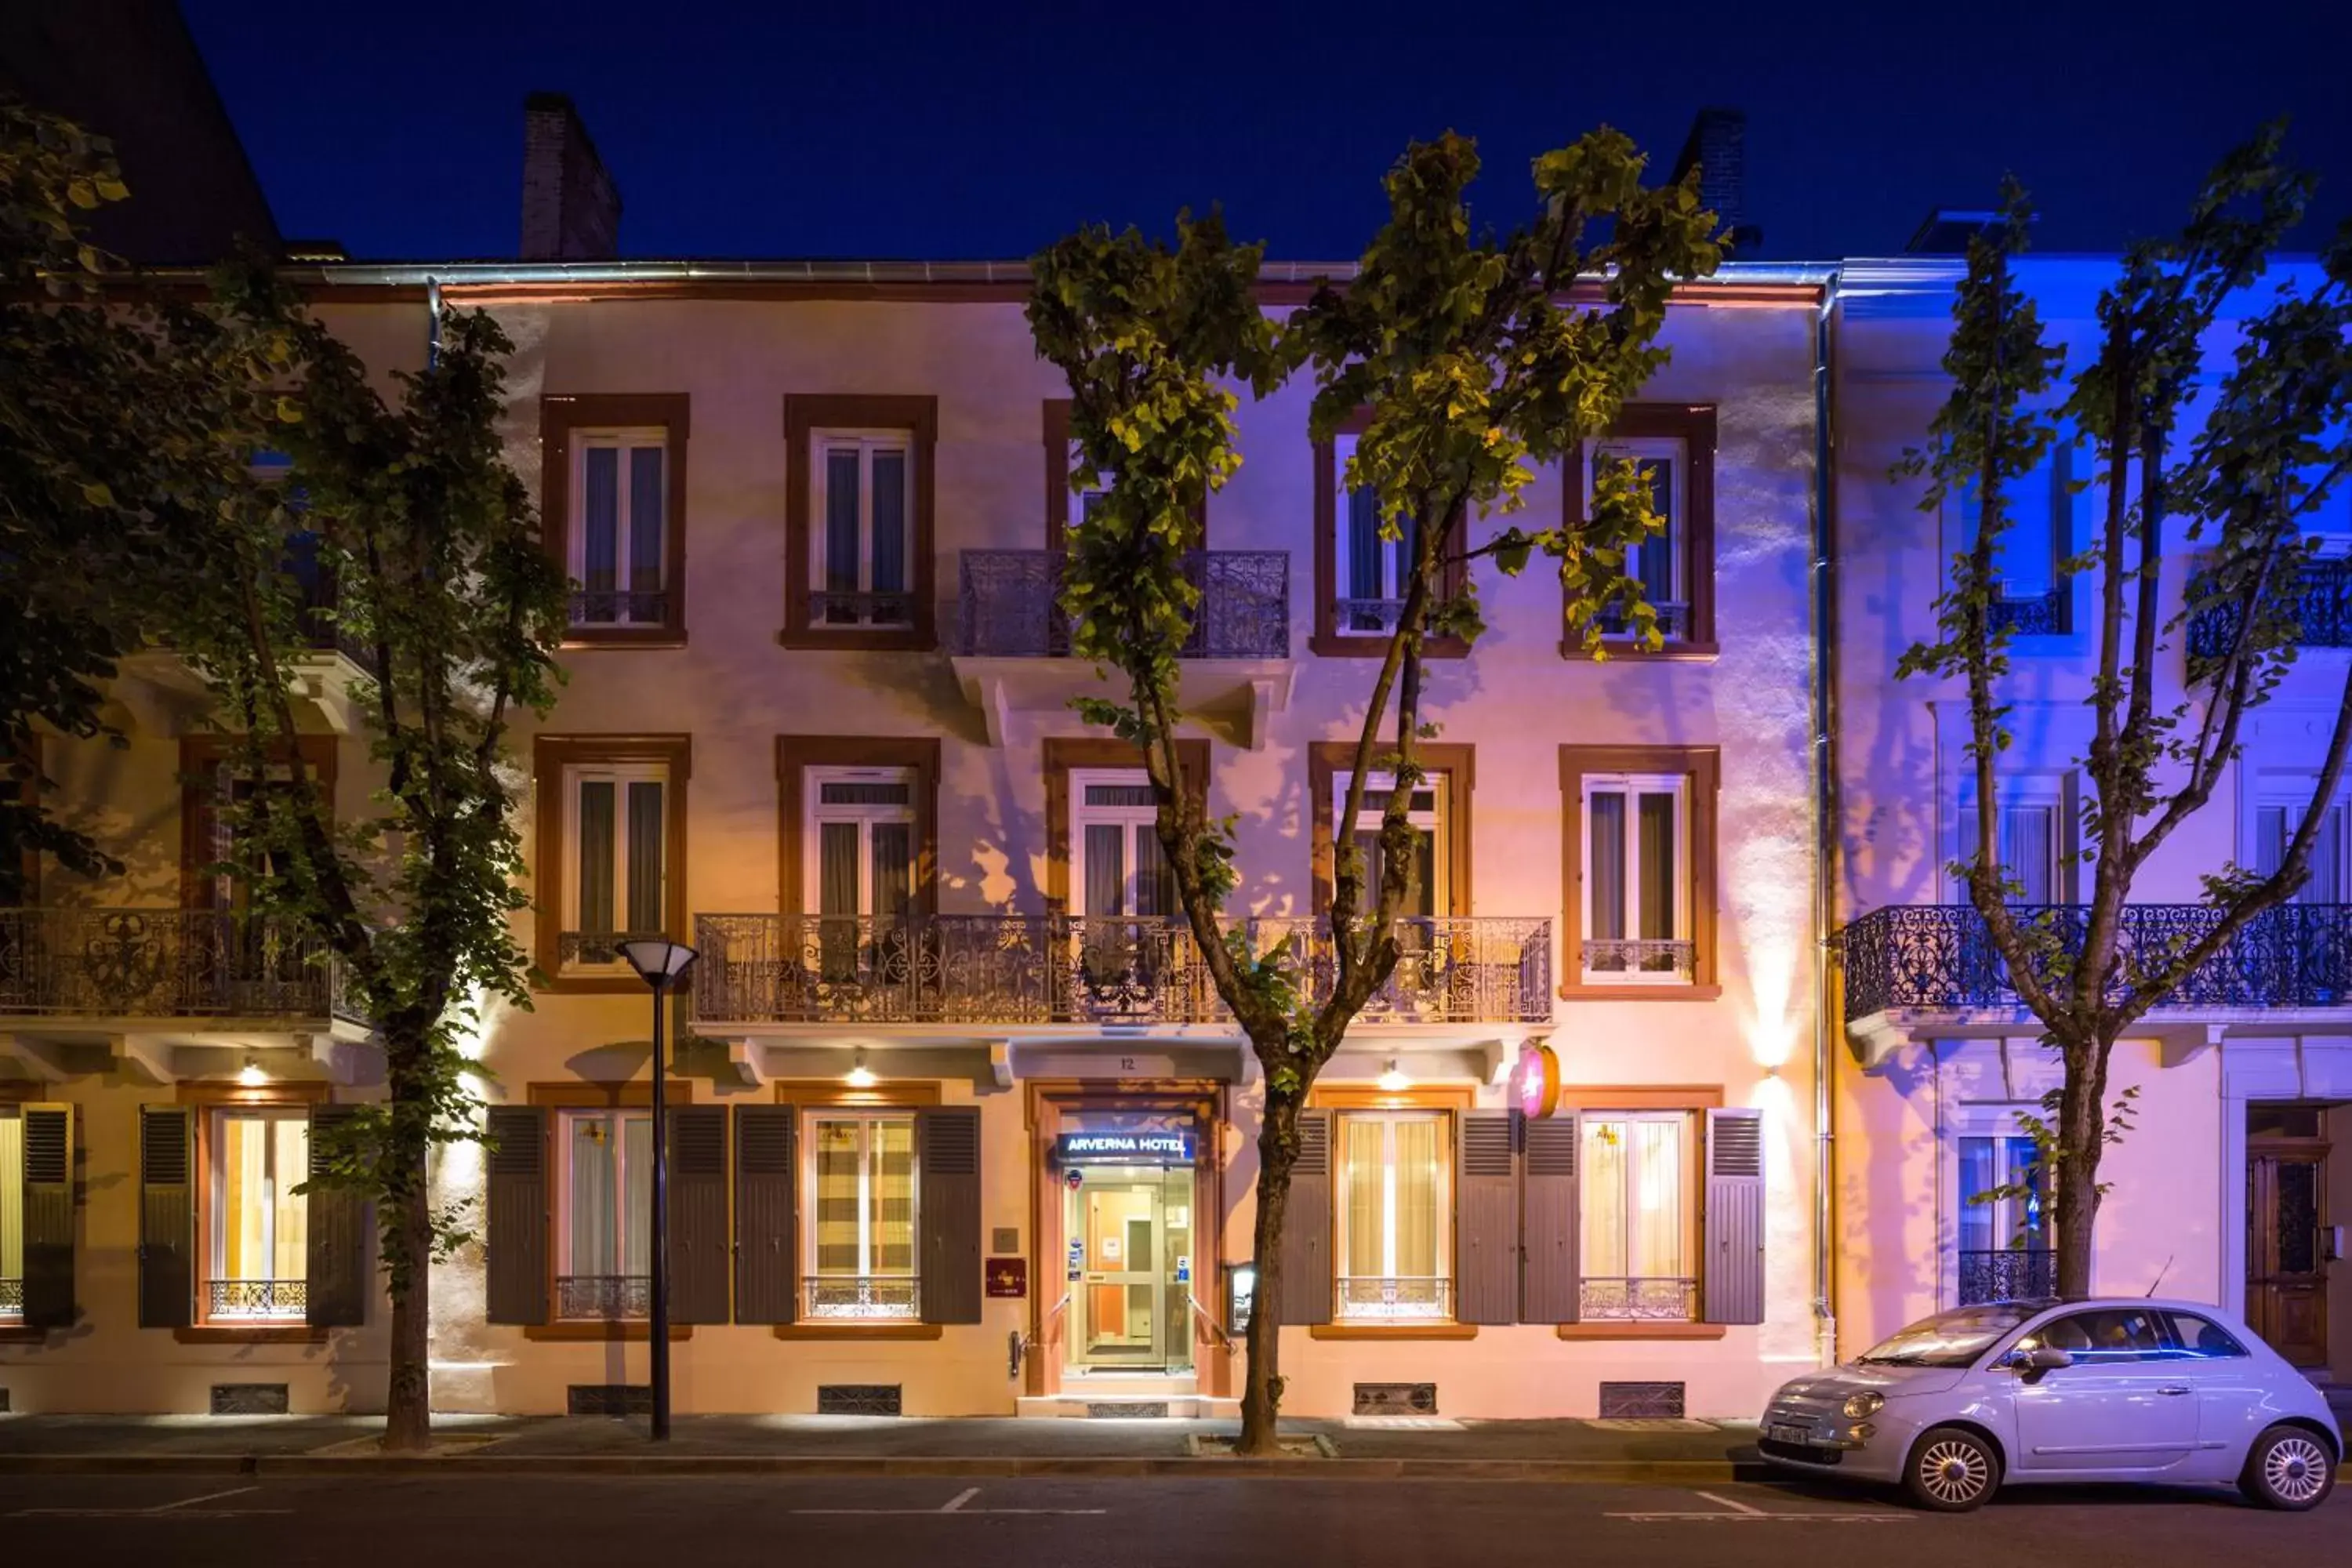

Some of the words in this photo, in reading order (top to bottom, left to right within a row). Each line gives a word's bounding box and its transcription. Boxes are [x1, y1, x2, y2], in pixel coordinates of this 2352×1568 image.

[1121, 1058, 1136, 1070] 12
[1068, 1138, 1136, 1151] ARVERNA
[1139, 1138, 1186, 1152] HOTEL
